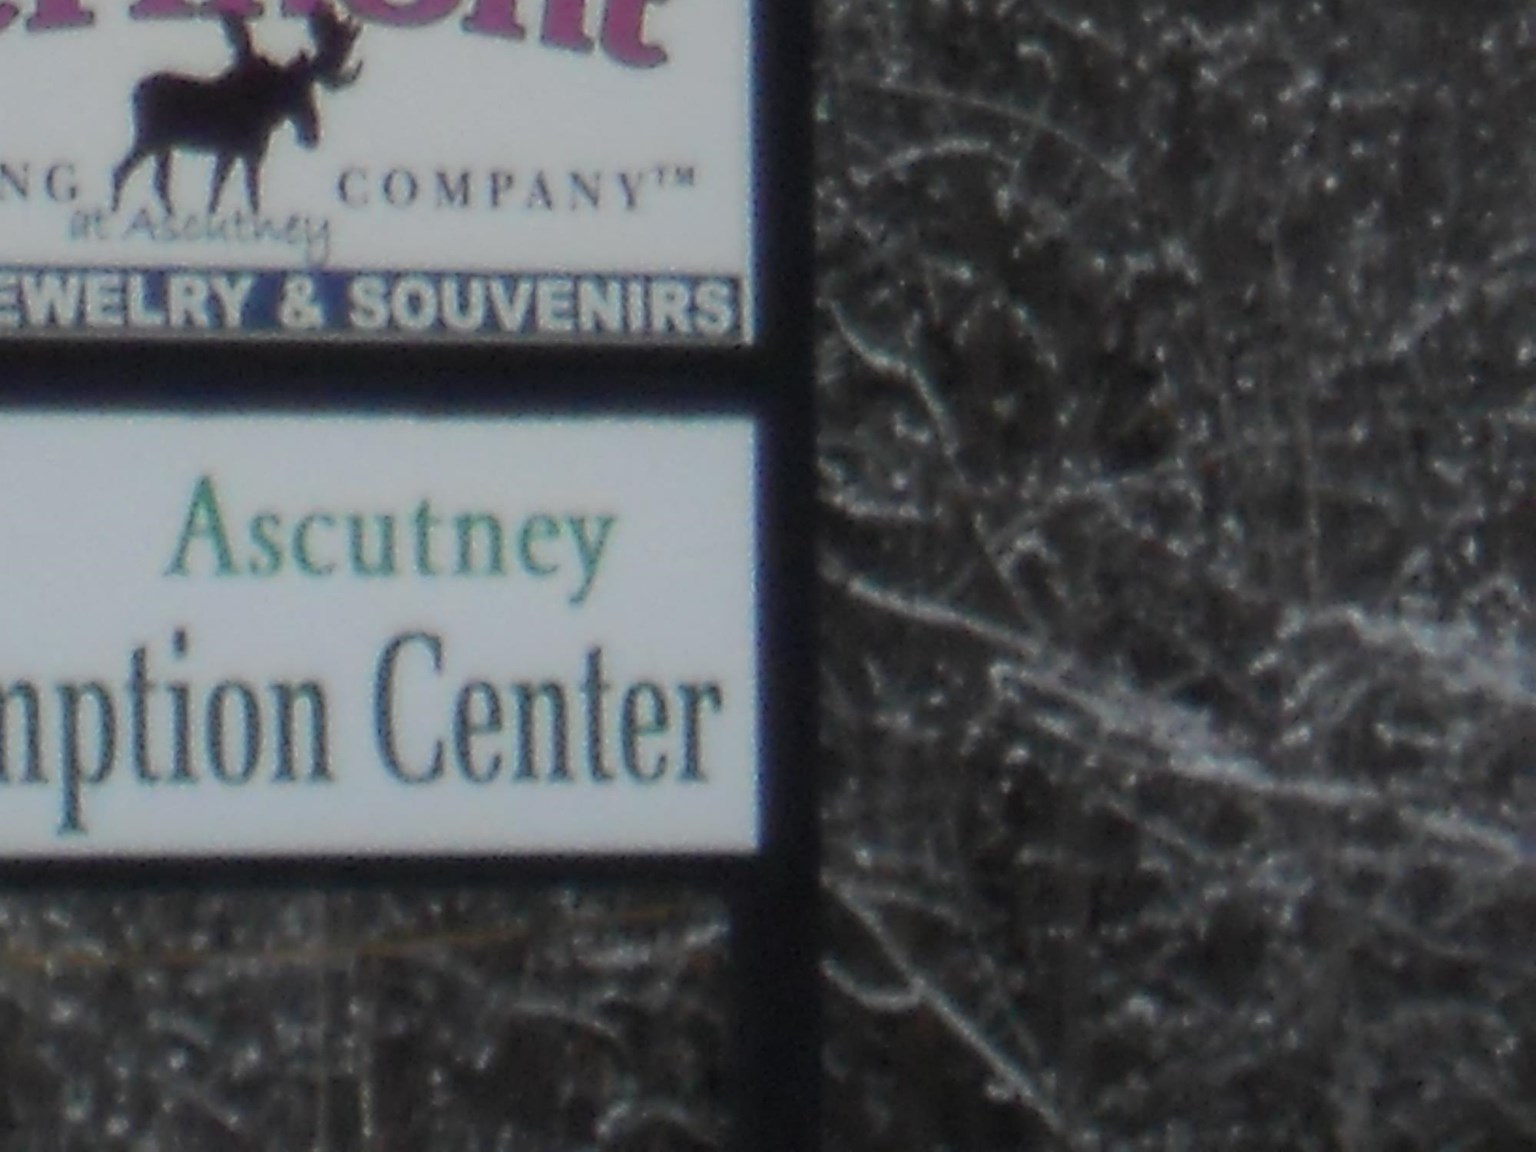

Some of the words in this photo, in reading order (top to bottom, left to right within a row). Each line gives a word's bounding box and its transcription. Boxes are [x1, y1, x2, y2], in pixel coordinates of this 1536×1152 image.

[122, 208, 332, 266] Ascutney
[277, 272, 325, 334] &
[348, 274, 736, 336] SOUVENIRS
[163, 473, 619, 605] Ascutney
[373, 630, 725, 788] Center
